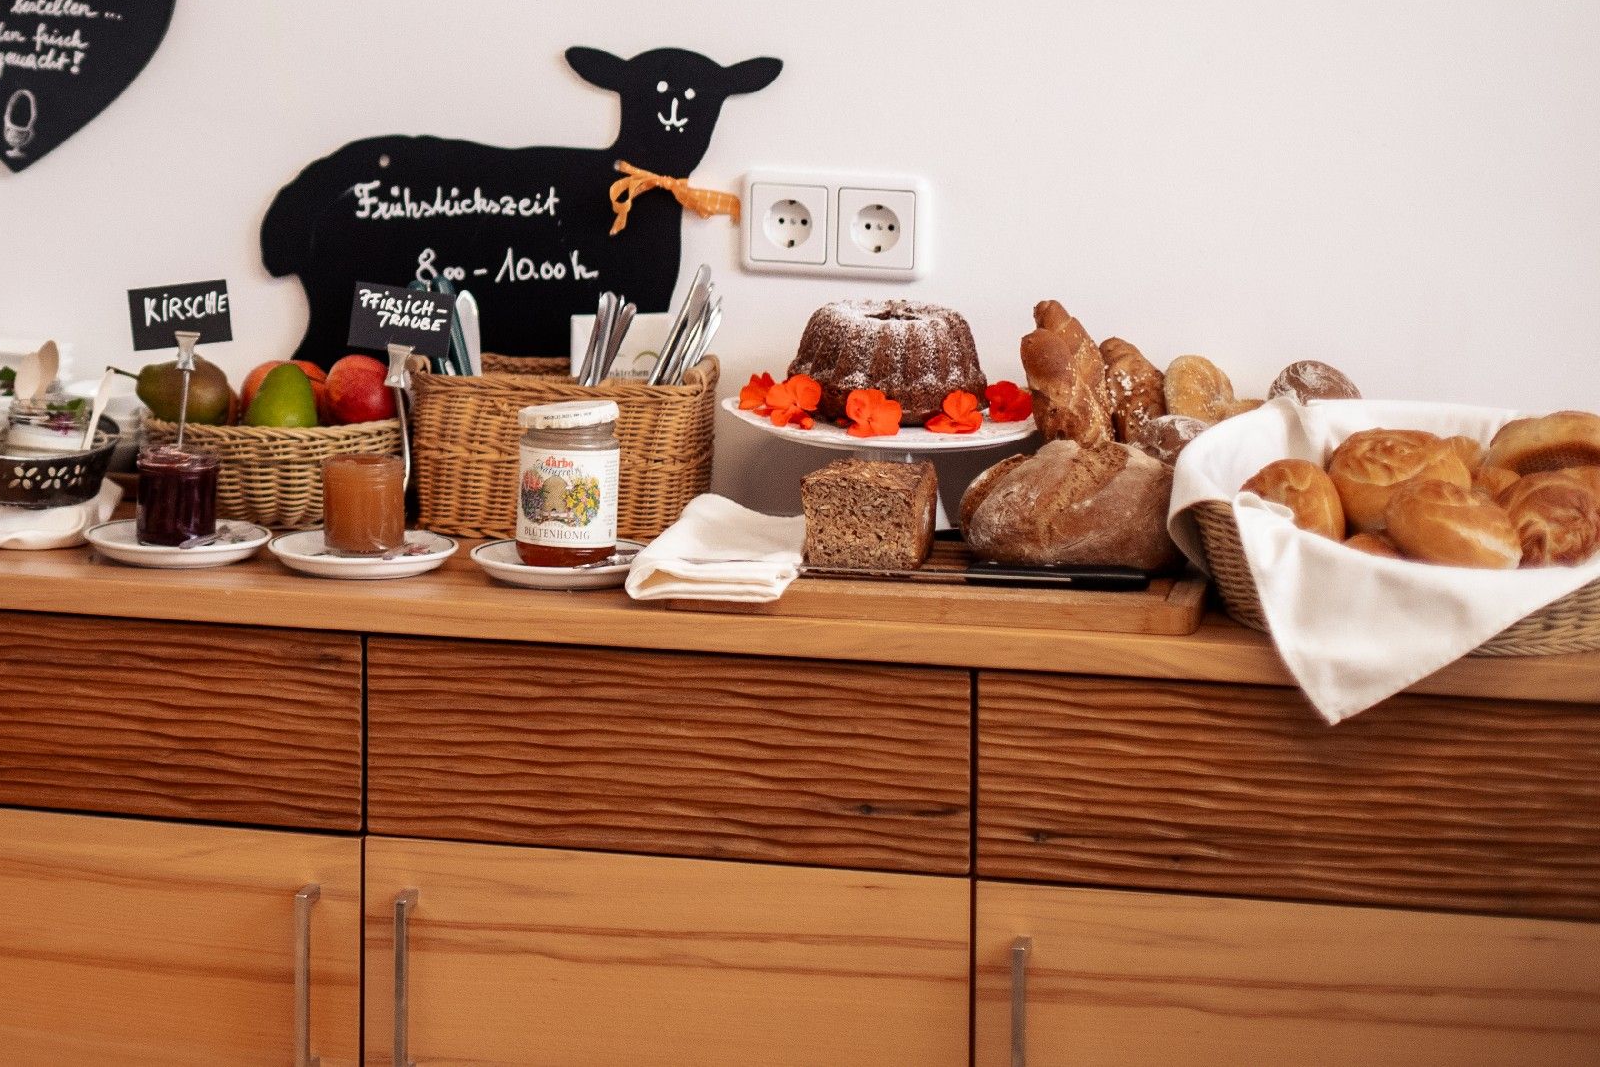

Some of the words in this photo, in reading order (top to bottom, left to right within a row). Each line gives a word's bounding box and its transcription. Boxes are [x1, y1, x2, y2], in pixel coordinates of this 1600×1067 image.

[33, 22, 88, 52] frisch
[353, 179, 560, 220] Frühstückszeit
[377, 311, 447, 332] TRAUBE
